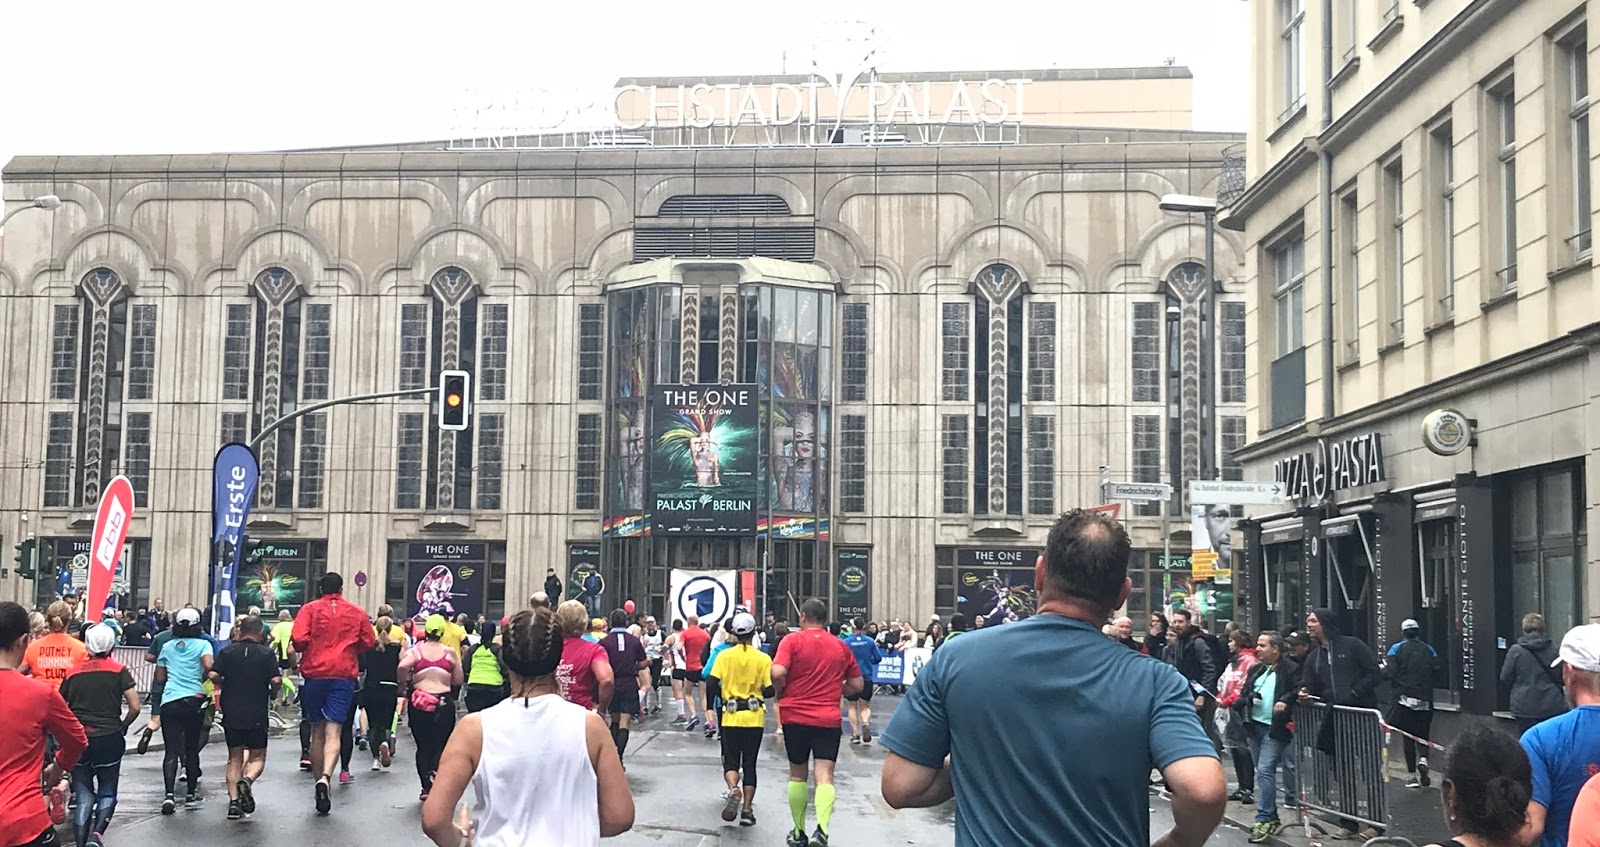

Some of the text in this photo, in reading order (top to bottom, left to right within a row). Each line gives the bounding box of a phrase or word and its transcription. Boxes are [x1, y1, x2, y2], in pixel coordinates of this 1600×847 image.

[868, 78, 1033, 125] PALAST
[663, 390, 748, 406] THE ONE
[1331, 432, 1381, 491] PASTA
[225, 465, 246, 528] Erste
[656, 499, 751, 511] PALAST BERLIN
[104, 511, 122, 561] rbb
[73, 542, 91, 551] THE
[425, 545, 469, 554] THE ONE
[975, 551, 1022, 561] THE ONE
[1158, 559, 1187, 567] PAST
[1459, 504, 1469, 689] RISTORANTE GIOTTO
[39, 646, 72, 657] PUTNEY
[45, 668, 67, 680] CLUB
